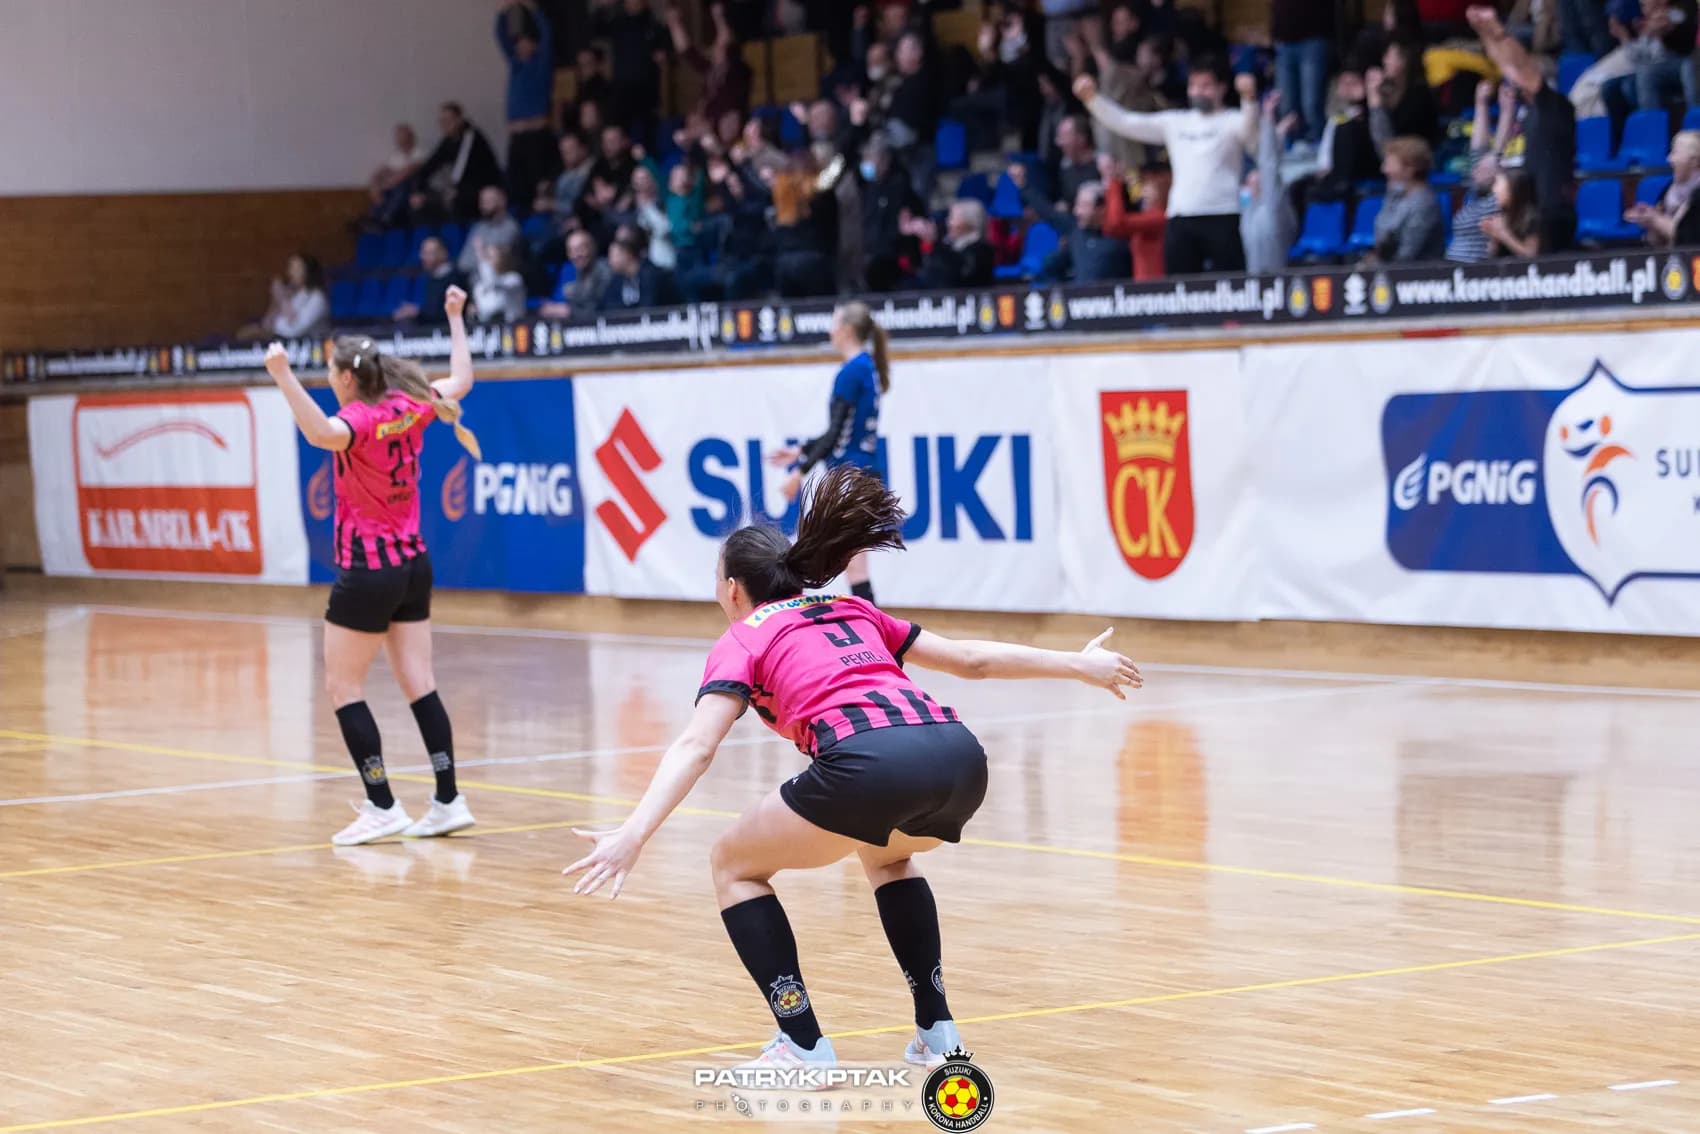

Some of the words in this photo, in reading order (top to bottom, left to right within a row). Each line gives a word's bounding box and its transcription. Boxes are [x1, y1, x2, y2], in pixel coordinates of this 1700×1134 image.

[1068, 277, 1284, 320] www.koronahandball.pl
[1397, 256, 1657, 303] www.koronahandball.pl
[1427, 459, 1538, 505] PGNiG
[1656, 448, 1700, 478] SU
[473, 462, 573, 517] PGNiG
[688, 432, 1034, 542] SUUKI
[1113, 464, 1182, 559] CK
